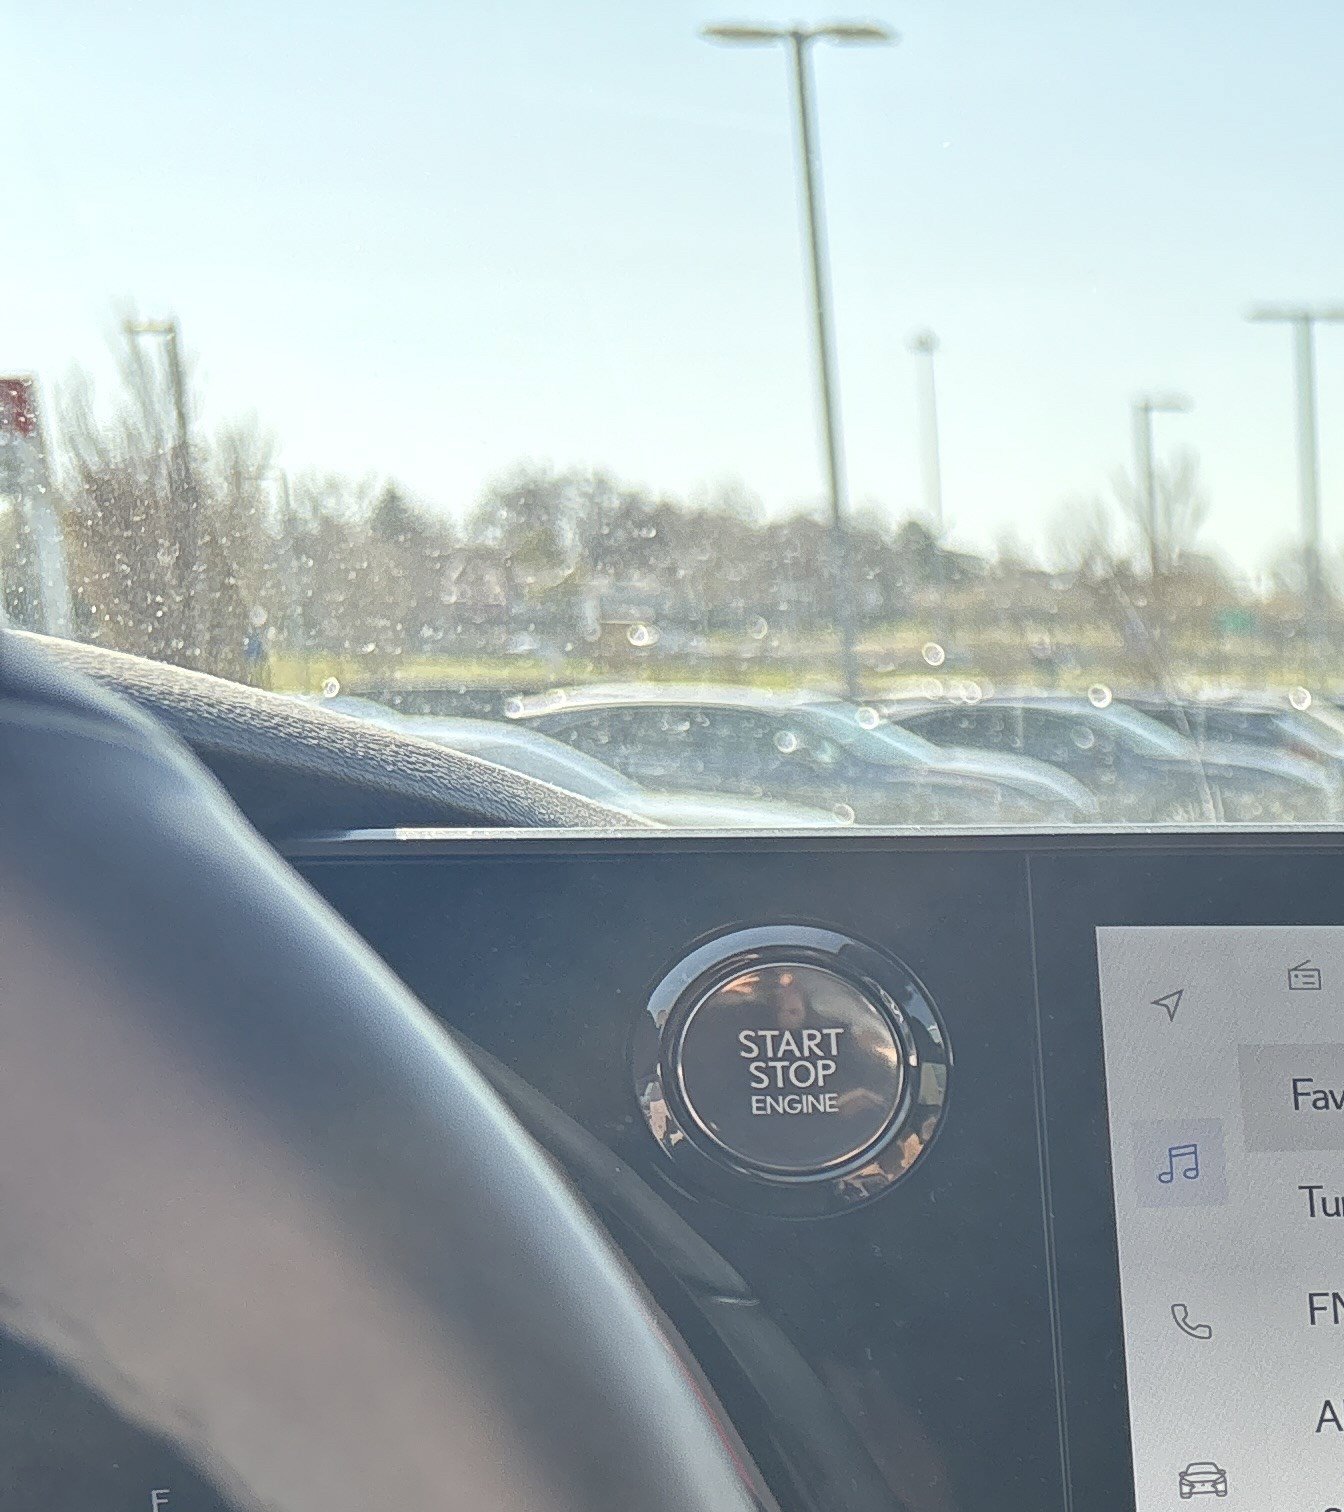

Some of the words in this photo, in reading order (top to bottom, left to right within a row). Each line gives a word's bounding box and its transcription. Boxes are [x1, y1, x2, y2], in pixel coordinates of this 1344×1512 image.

[738, 1027, 844, 1058] START
[749, 1059, 836, 1089] STOP
[751, 1093, 840, 1115] ENGINE
